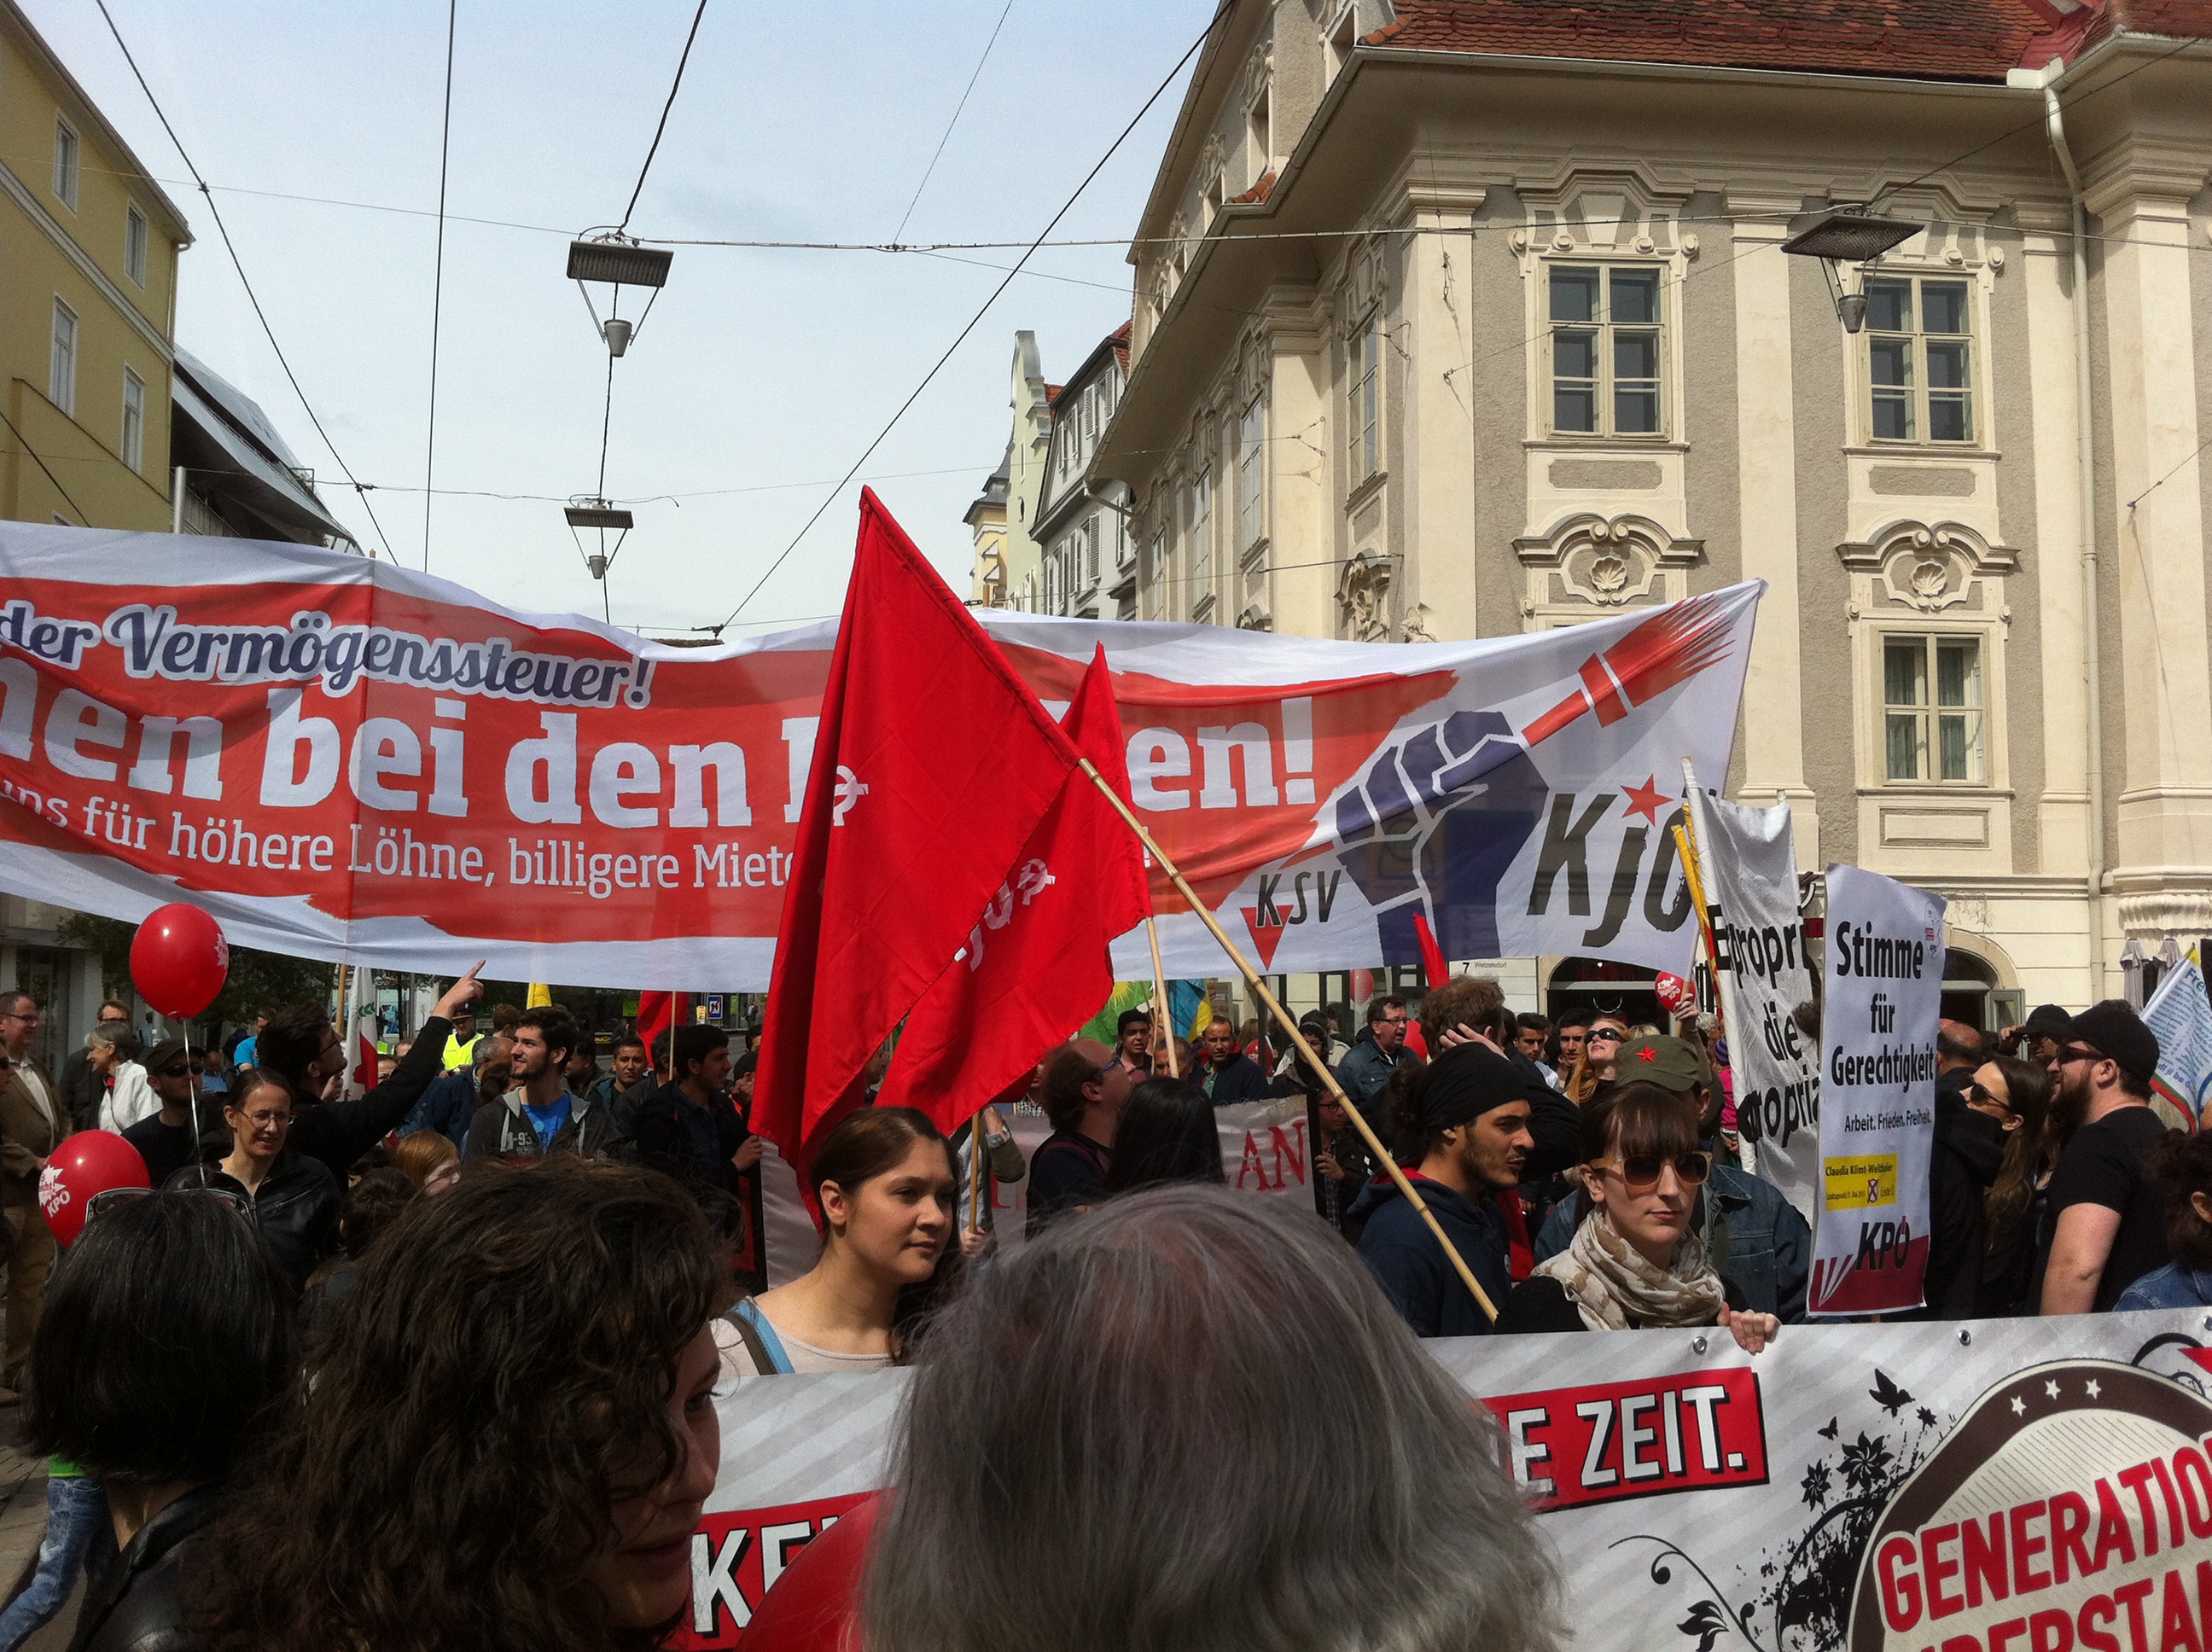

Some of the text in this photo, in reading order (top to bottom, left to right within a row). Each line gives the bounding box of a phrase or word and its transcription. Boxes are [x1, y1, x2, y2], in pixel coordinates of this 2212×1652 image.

[0, 604, 655, 706] der Vermögenssteuer!
[259, 688, 468, 817] bei
[504, 711, 753, 829] den
[82, 795, 157, 851] für
[167, 811, 334, 872] höhere
[347, 823, 495, 887] Löhne,
[508, 837, 680, 899] billigere
[1255, 865, 1342, 928] KSV
[1837, 920, 1924, 980] Stimme
[1763, 1001, 1803, 1062] die
[1870, 992, 1895, 1033] für
[1831, 1043, 1934, 1093] Gerechtigkeit
[1844, 1114, 1876, 1133] Arbeit.
[1575, 1384, 1747, 1488] ZEIT.
[1877, 1438, 2212, 1633] GENERATIO
